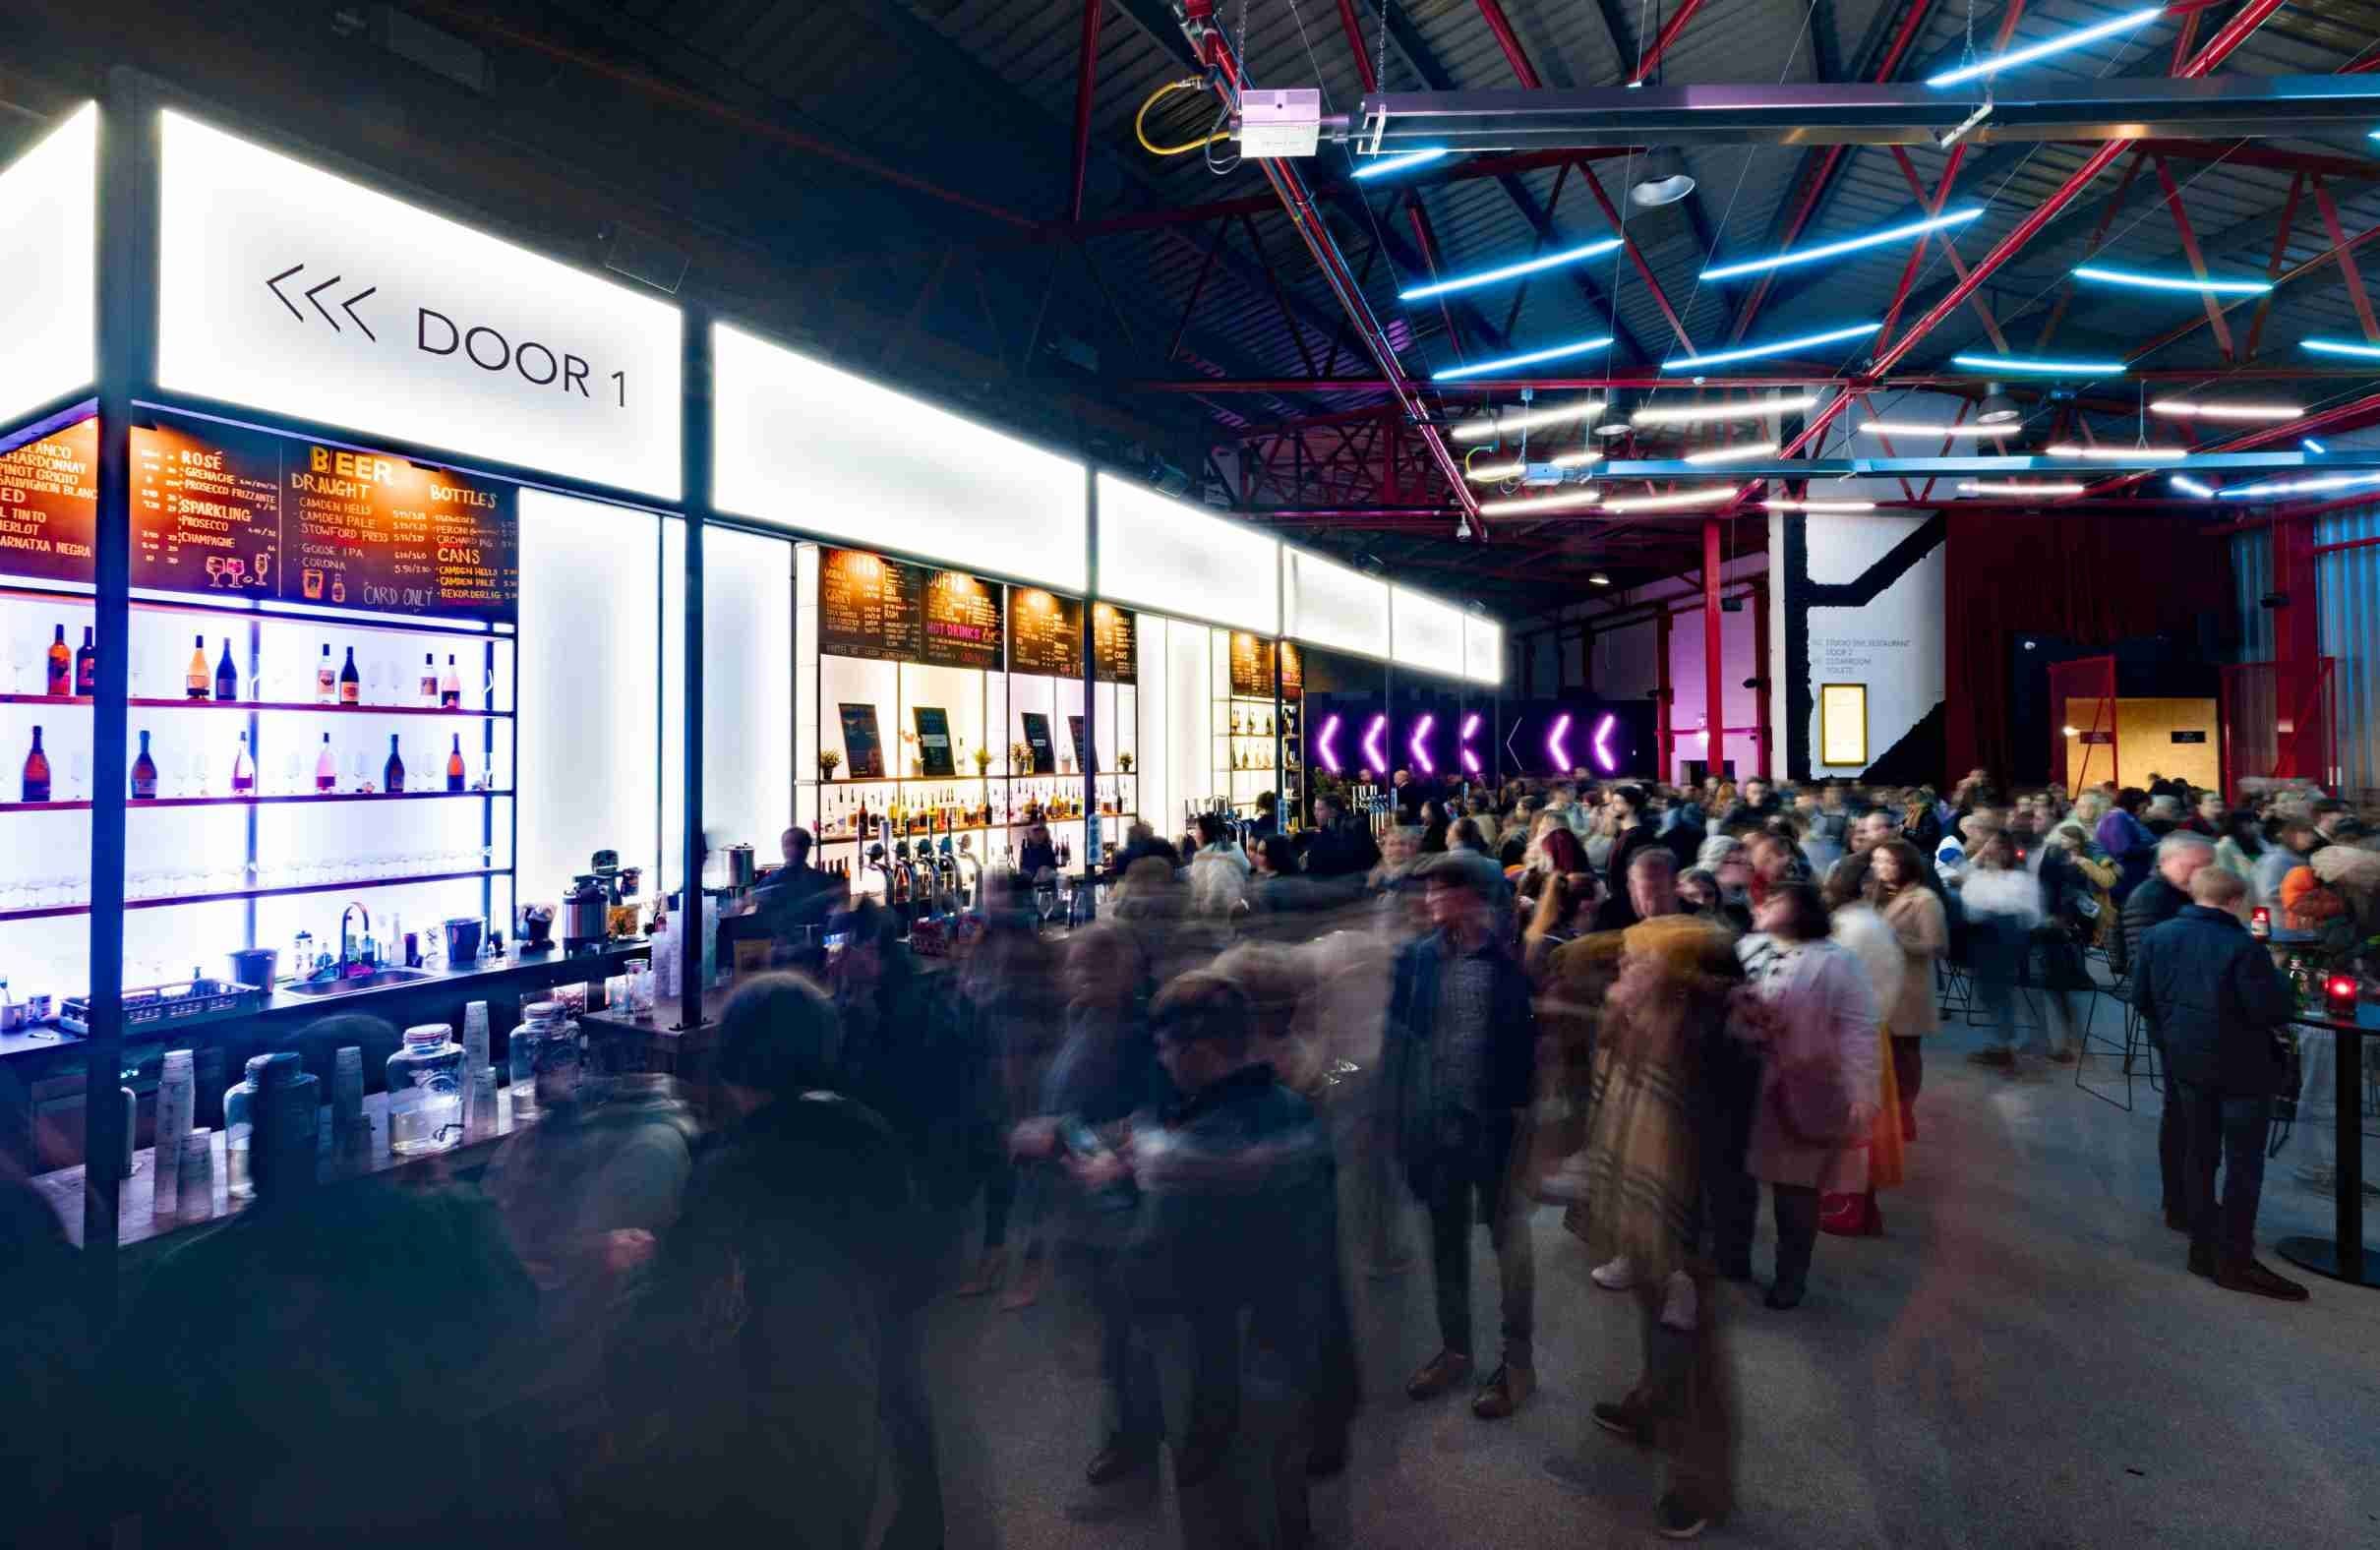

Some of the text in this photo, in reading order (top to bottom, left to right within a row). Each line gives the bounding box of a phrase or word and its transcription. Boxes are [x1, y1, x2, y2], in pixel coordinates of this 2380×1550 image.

[418, 307, 625, 408] DOOR 1
[181, 450, 222, 471] ROSÉ
[310, 446, 393, 487] BEER
[63, 485, 98, 501] BLANC
[185, 479, 229, 496] PROSECCO
[291, 473, 371, 500] DRAUGHT
[299, 497, 340, 512] CAMDEN
[430, 484, 498, 508] BOTTLES
[12, 507, 47, 523] TINTO
[179, 499, 252, 522] SPARKLING
[181, 514, 229, 531] PROSECCO
[299, 510, 343, 524] CAMDEN
[347, 515, 377, 529] PALE
[300, 522, 357, 539] STOWFORD
[182, 531, 236, 548] CHAMPAGNE
[56, 542, 91, 558] NEGRA
[301, 543, 335, 556] GOOSE
[437, 547, 481, 565] CANS
[302, 557, 346, 570] CORONA
[363, 585, 433, 607] CARD ONLY
